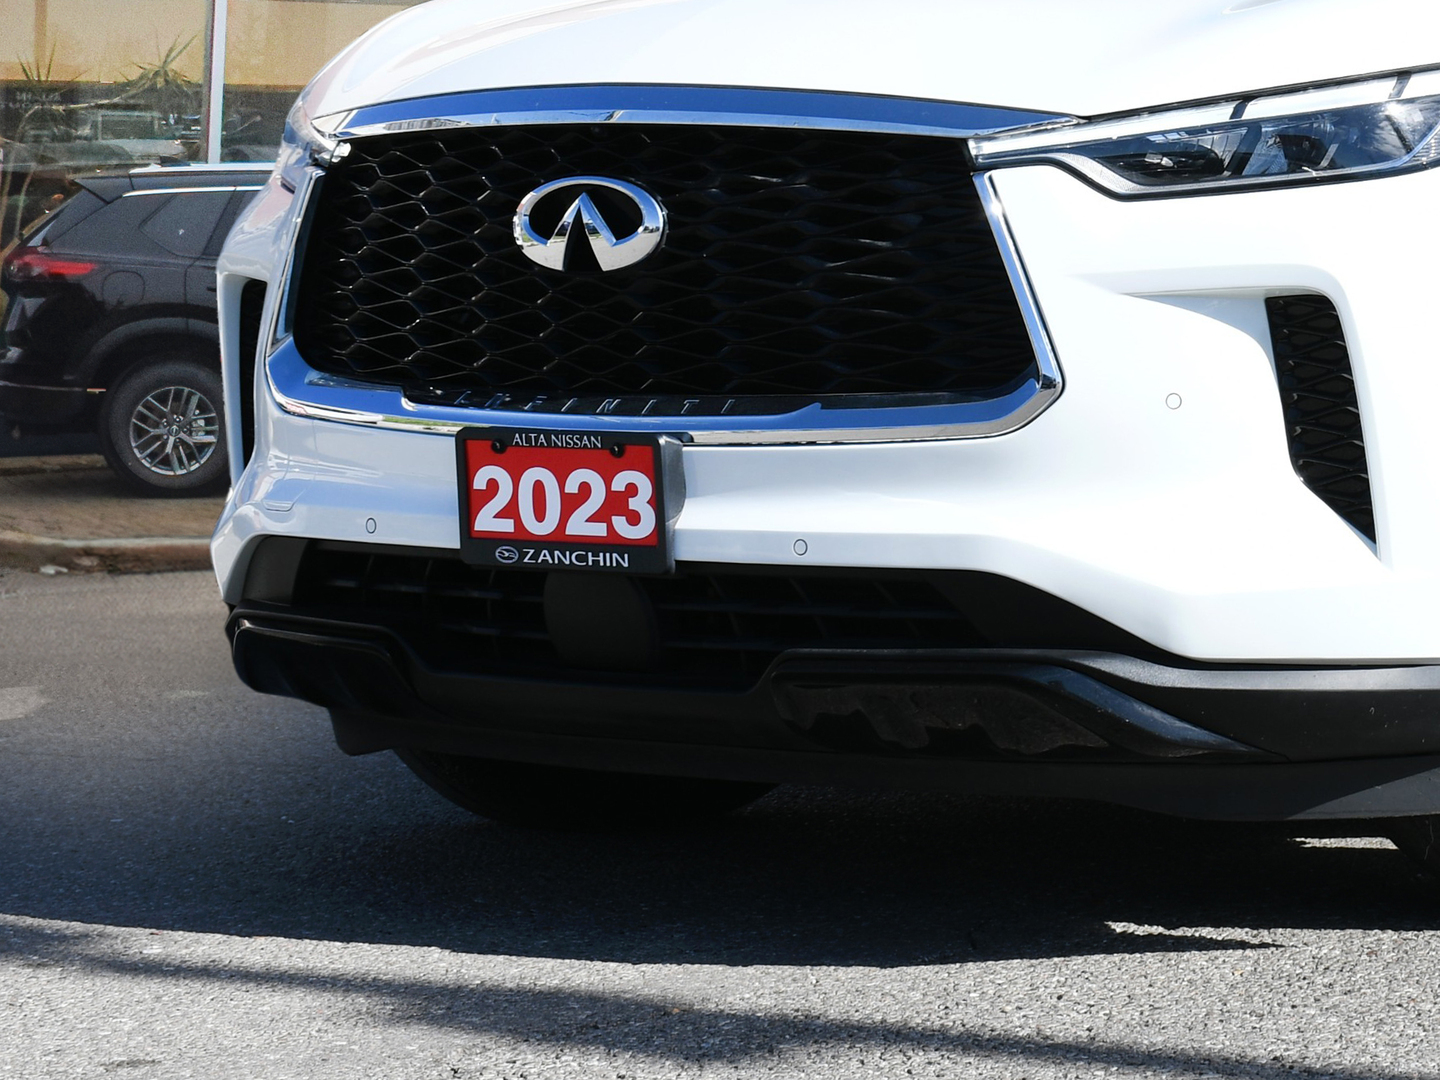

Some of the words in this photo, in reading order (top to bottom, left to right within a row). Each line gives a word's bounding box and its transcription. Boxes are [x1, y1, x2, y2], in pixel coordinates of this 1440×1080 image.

[512, 433, 548, 447] ALTA
[550, 434, 603, 449] NISSAN
[472, 465, 656, 540] 2023
[522, 548, 629, 568] ZANCHIN
